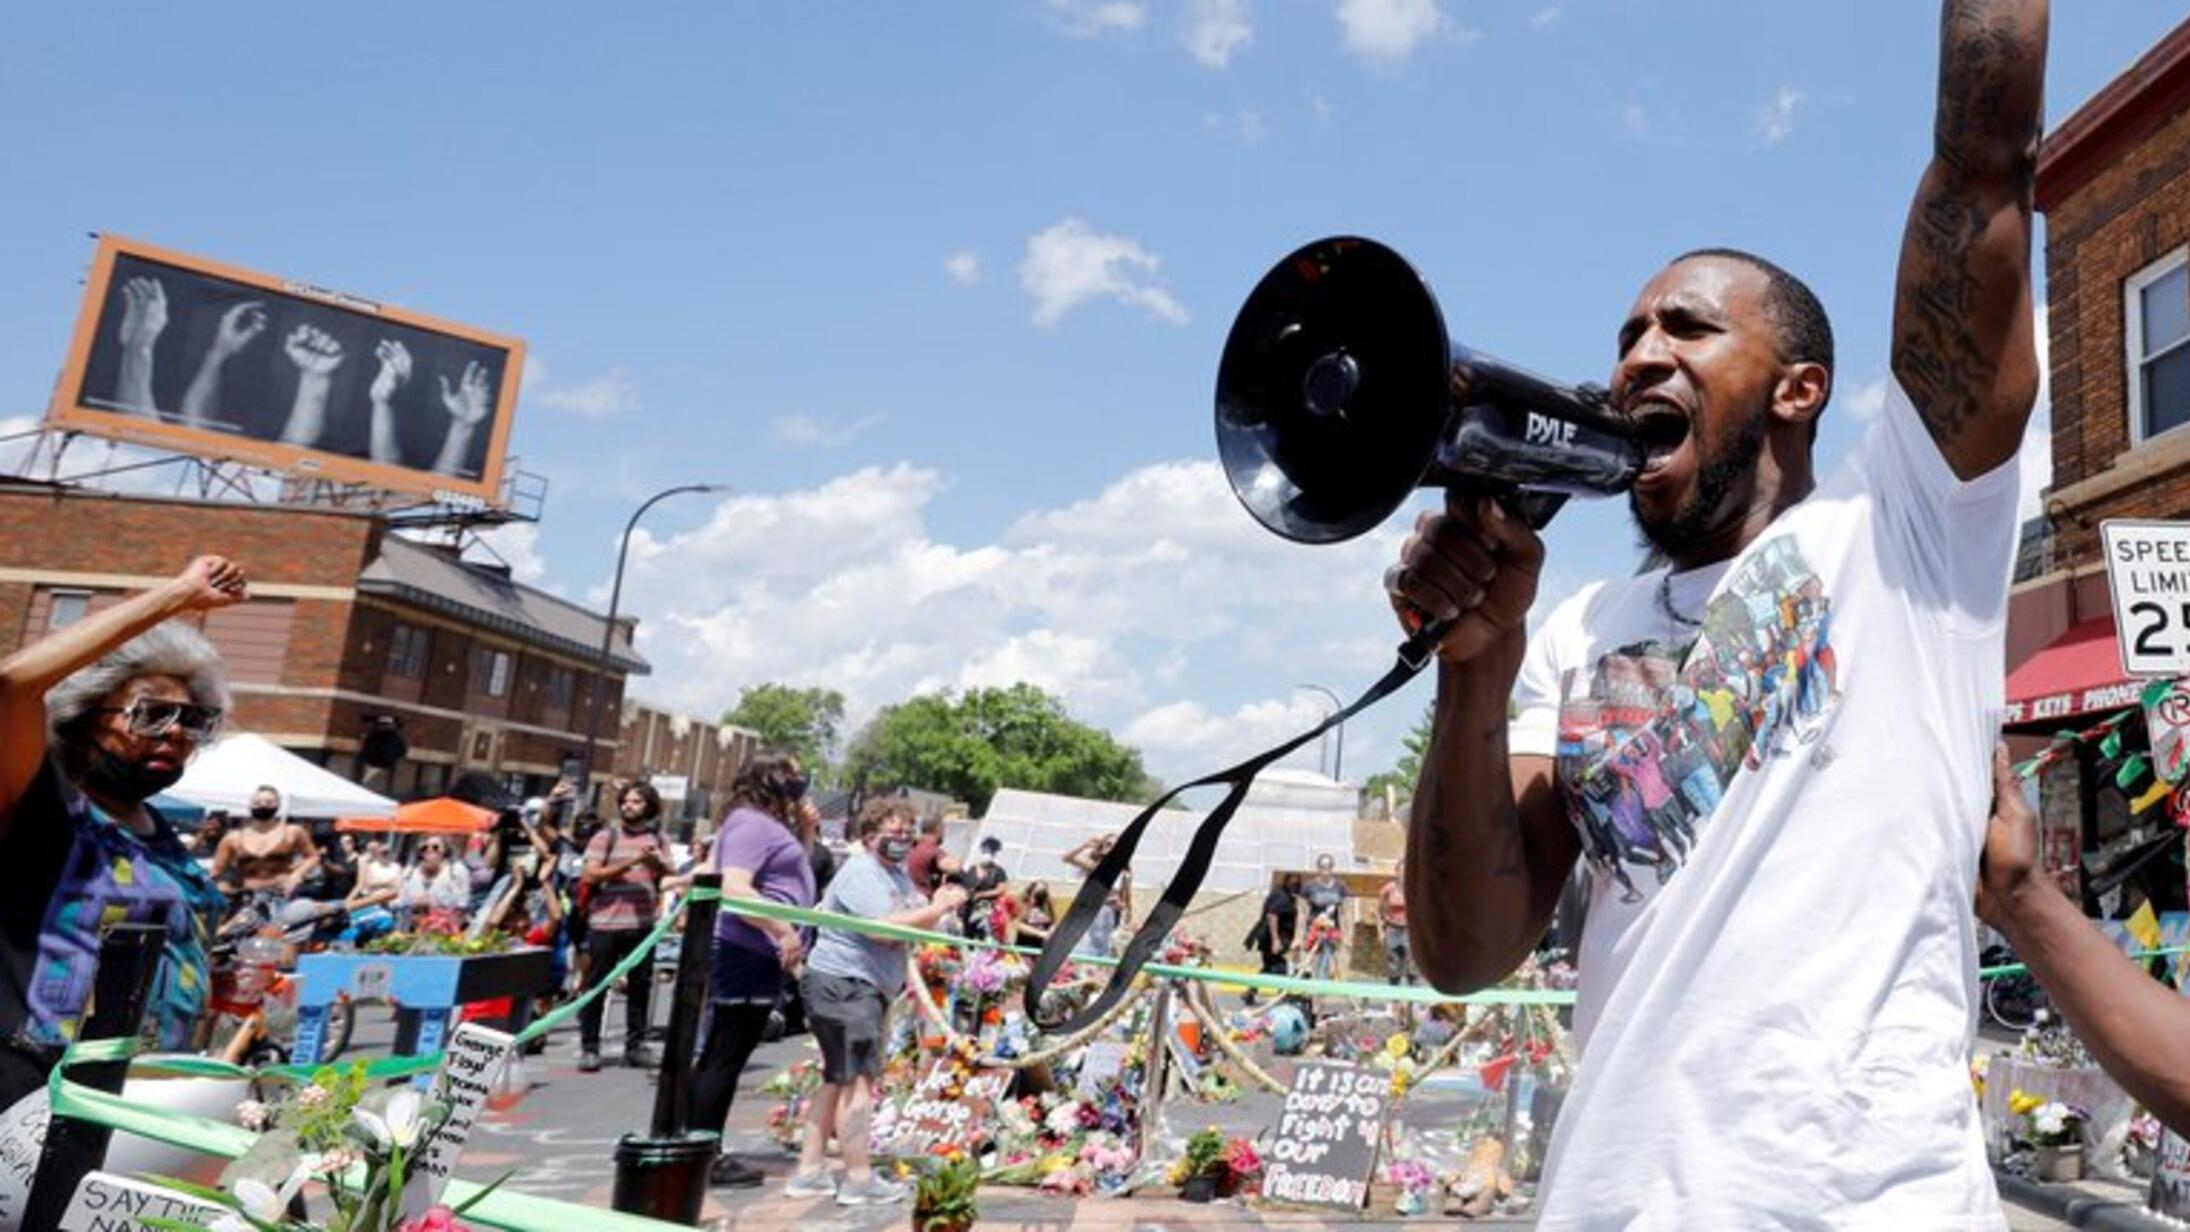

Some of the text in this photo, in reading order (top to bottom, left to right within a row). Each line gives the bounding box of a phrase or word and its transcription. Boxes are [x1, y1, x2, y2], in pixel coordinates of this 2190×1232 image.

[1525, 411, 1577, 450] PYLE
[2116, 539, 2190, 563] SPEE
[2131, 570, 2190, 594] LIMI
[2129, 601, 2190, 656] 2
[455, 1030, 504, 1062] George
[84, 1179, 151, 1217] SAY
